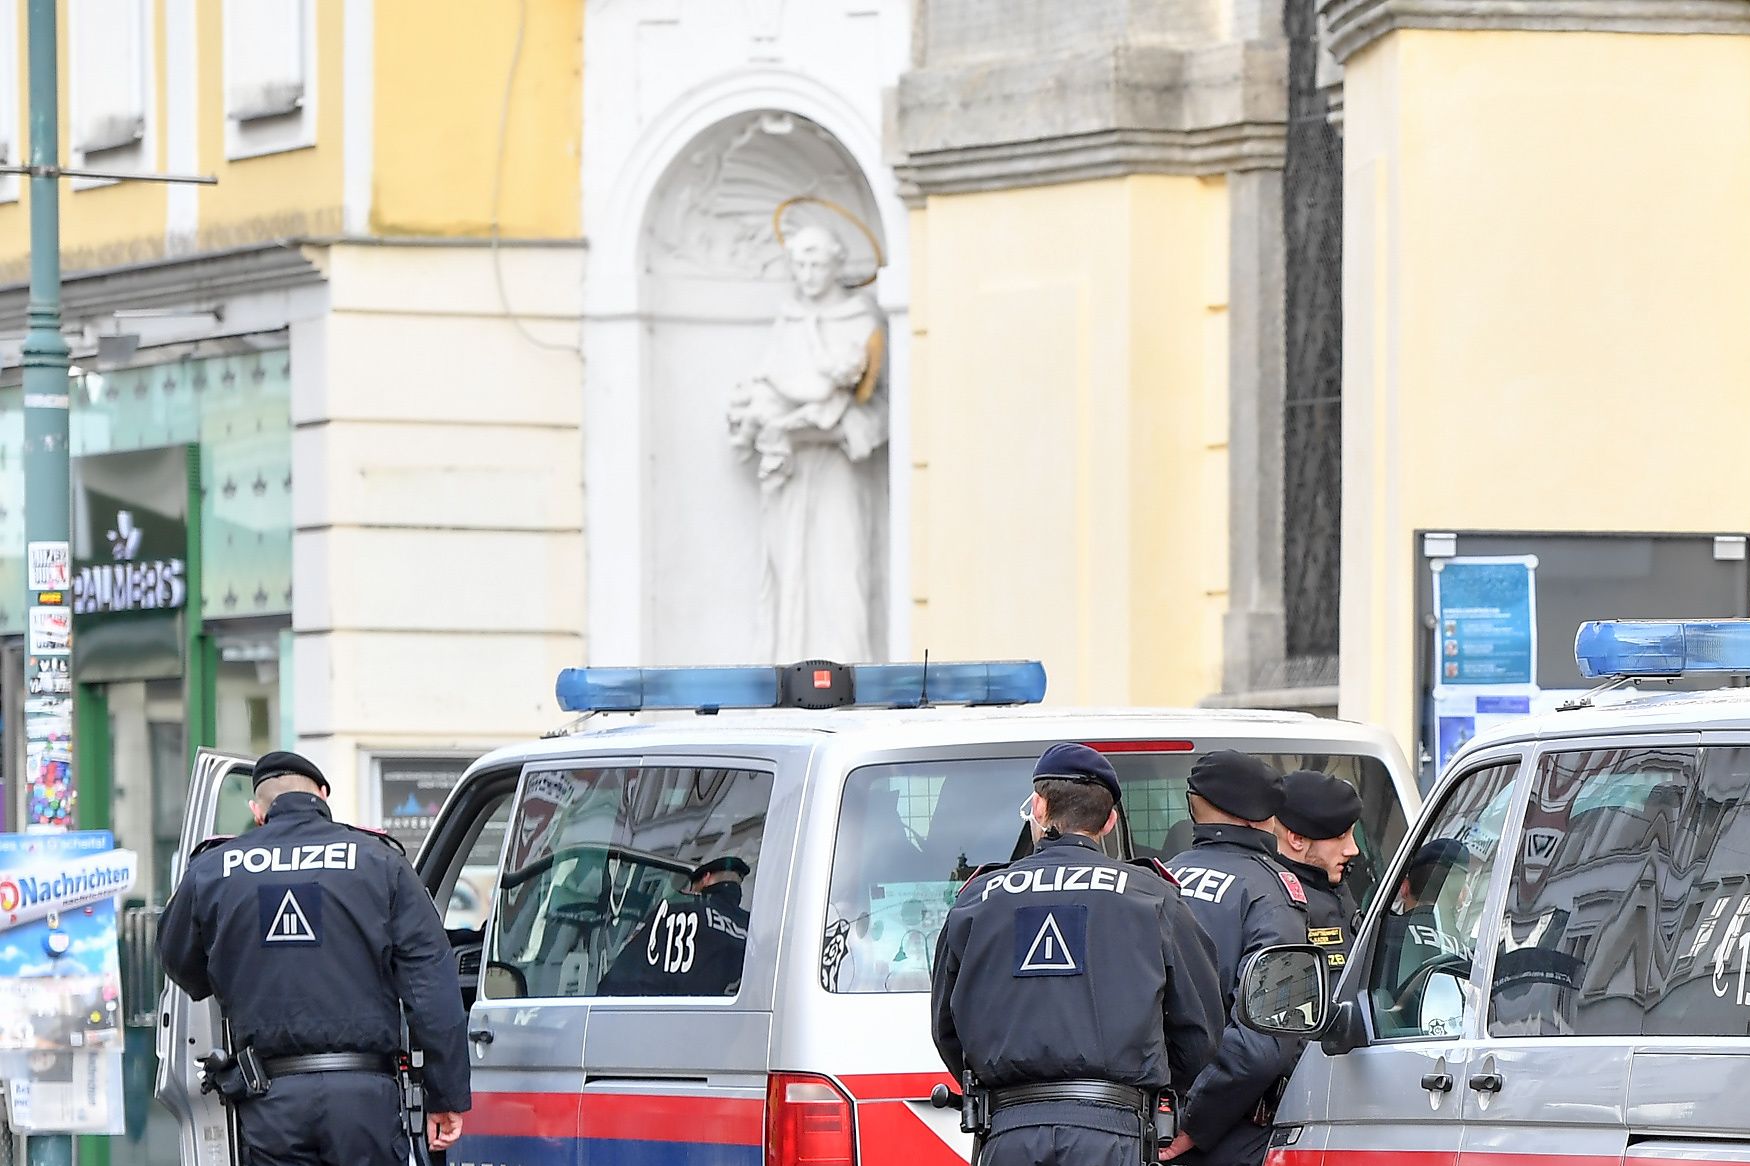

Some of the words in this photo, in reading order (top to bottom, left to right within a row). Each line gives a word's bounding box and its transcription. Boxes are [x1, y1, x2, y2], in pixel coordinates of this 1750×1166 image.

[222, 842, 357, 877] POLIZEI
[981, 866, 1129, 902] POLIZEI
[664, 912, 698, 974] 133
